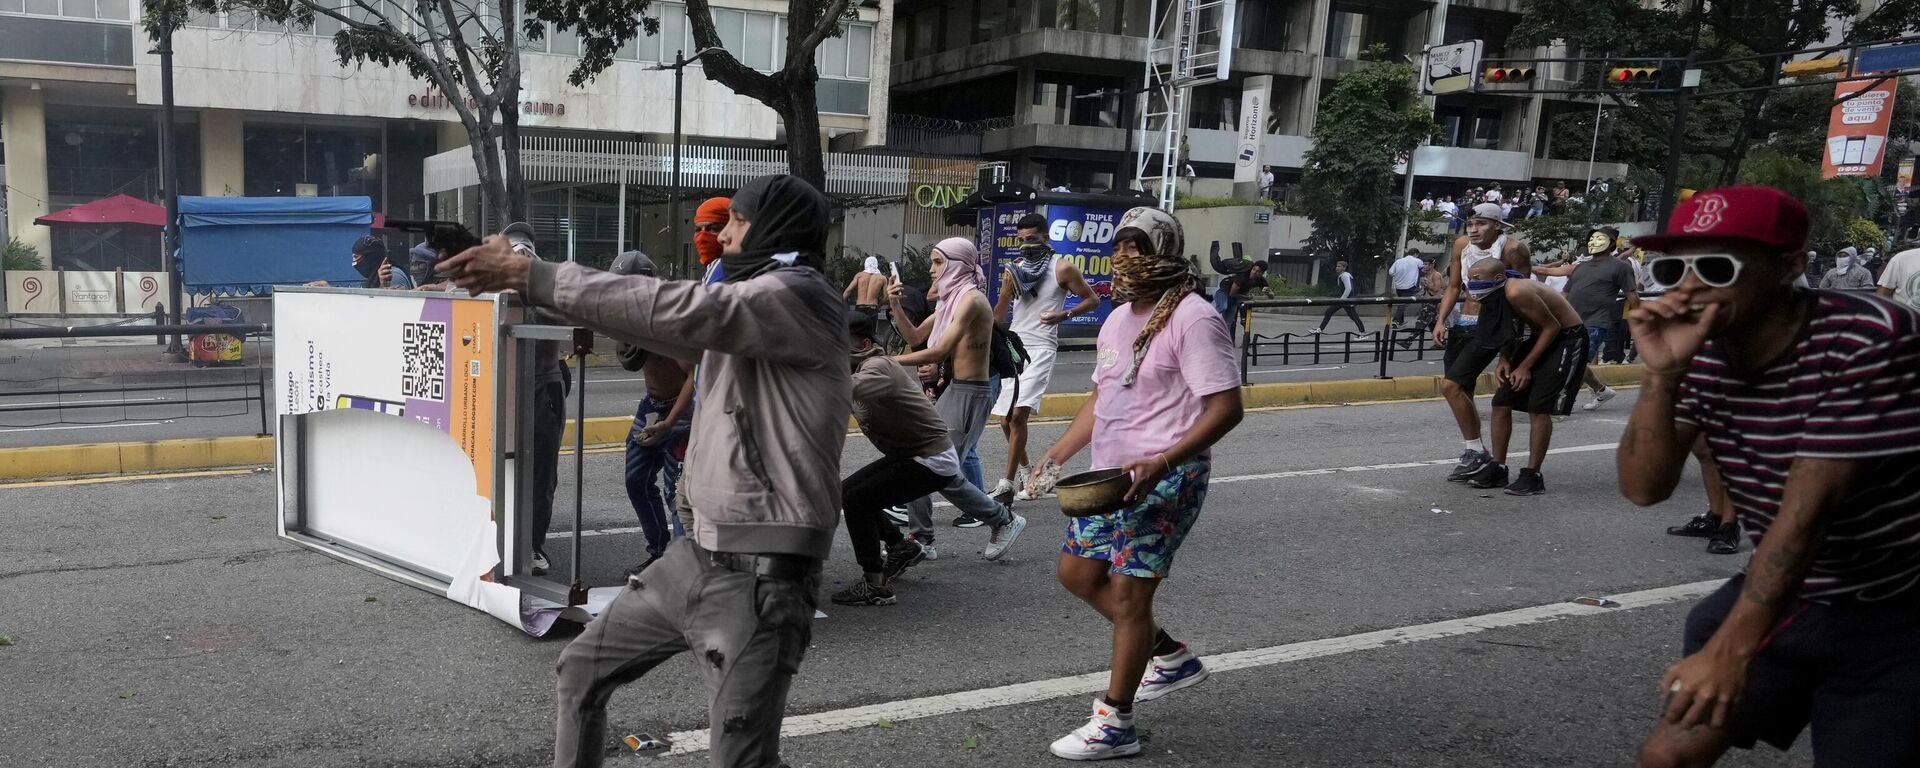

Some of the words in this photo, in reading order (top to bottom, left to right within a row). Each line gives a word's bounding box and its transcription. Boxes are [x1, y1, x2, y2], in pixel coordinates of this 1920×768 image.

[408, 87, 478, 110] edifiio
[1086, 213, 1113, 222] TRIPLE
[1683, 194, 1728, 232] B
[1049, 219, 1119, 243] GORD
